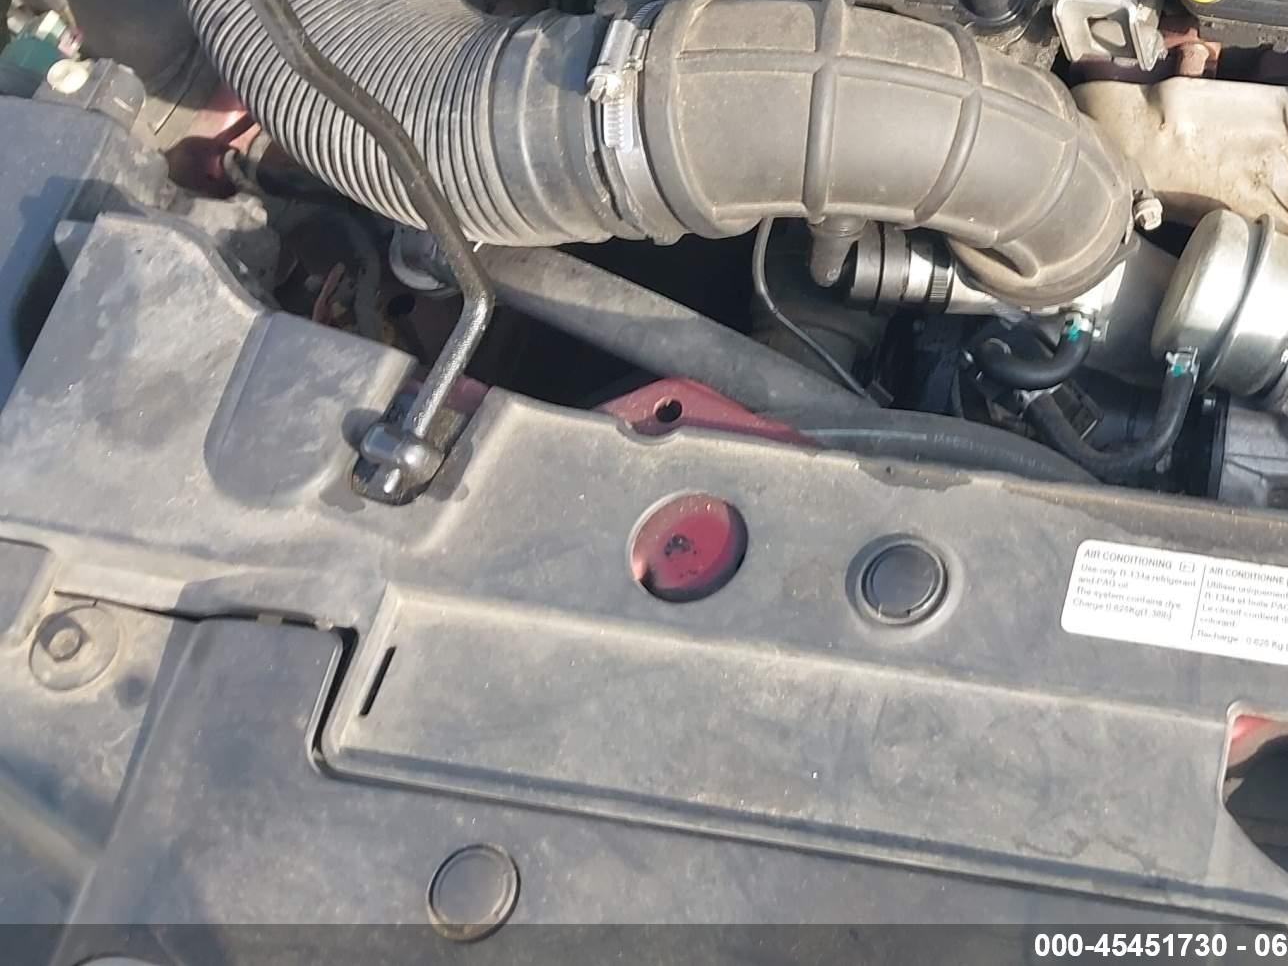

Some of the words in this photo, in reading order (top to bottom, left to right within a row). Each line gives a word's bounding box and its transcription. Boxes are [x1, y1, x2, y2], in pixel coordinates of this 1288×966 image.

[1084, 549, 1101, 558] AIR
[1102, 550, 1172, 570] CONDITIONING
[1209, 566, 1223, 575] AIR
